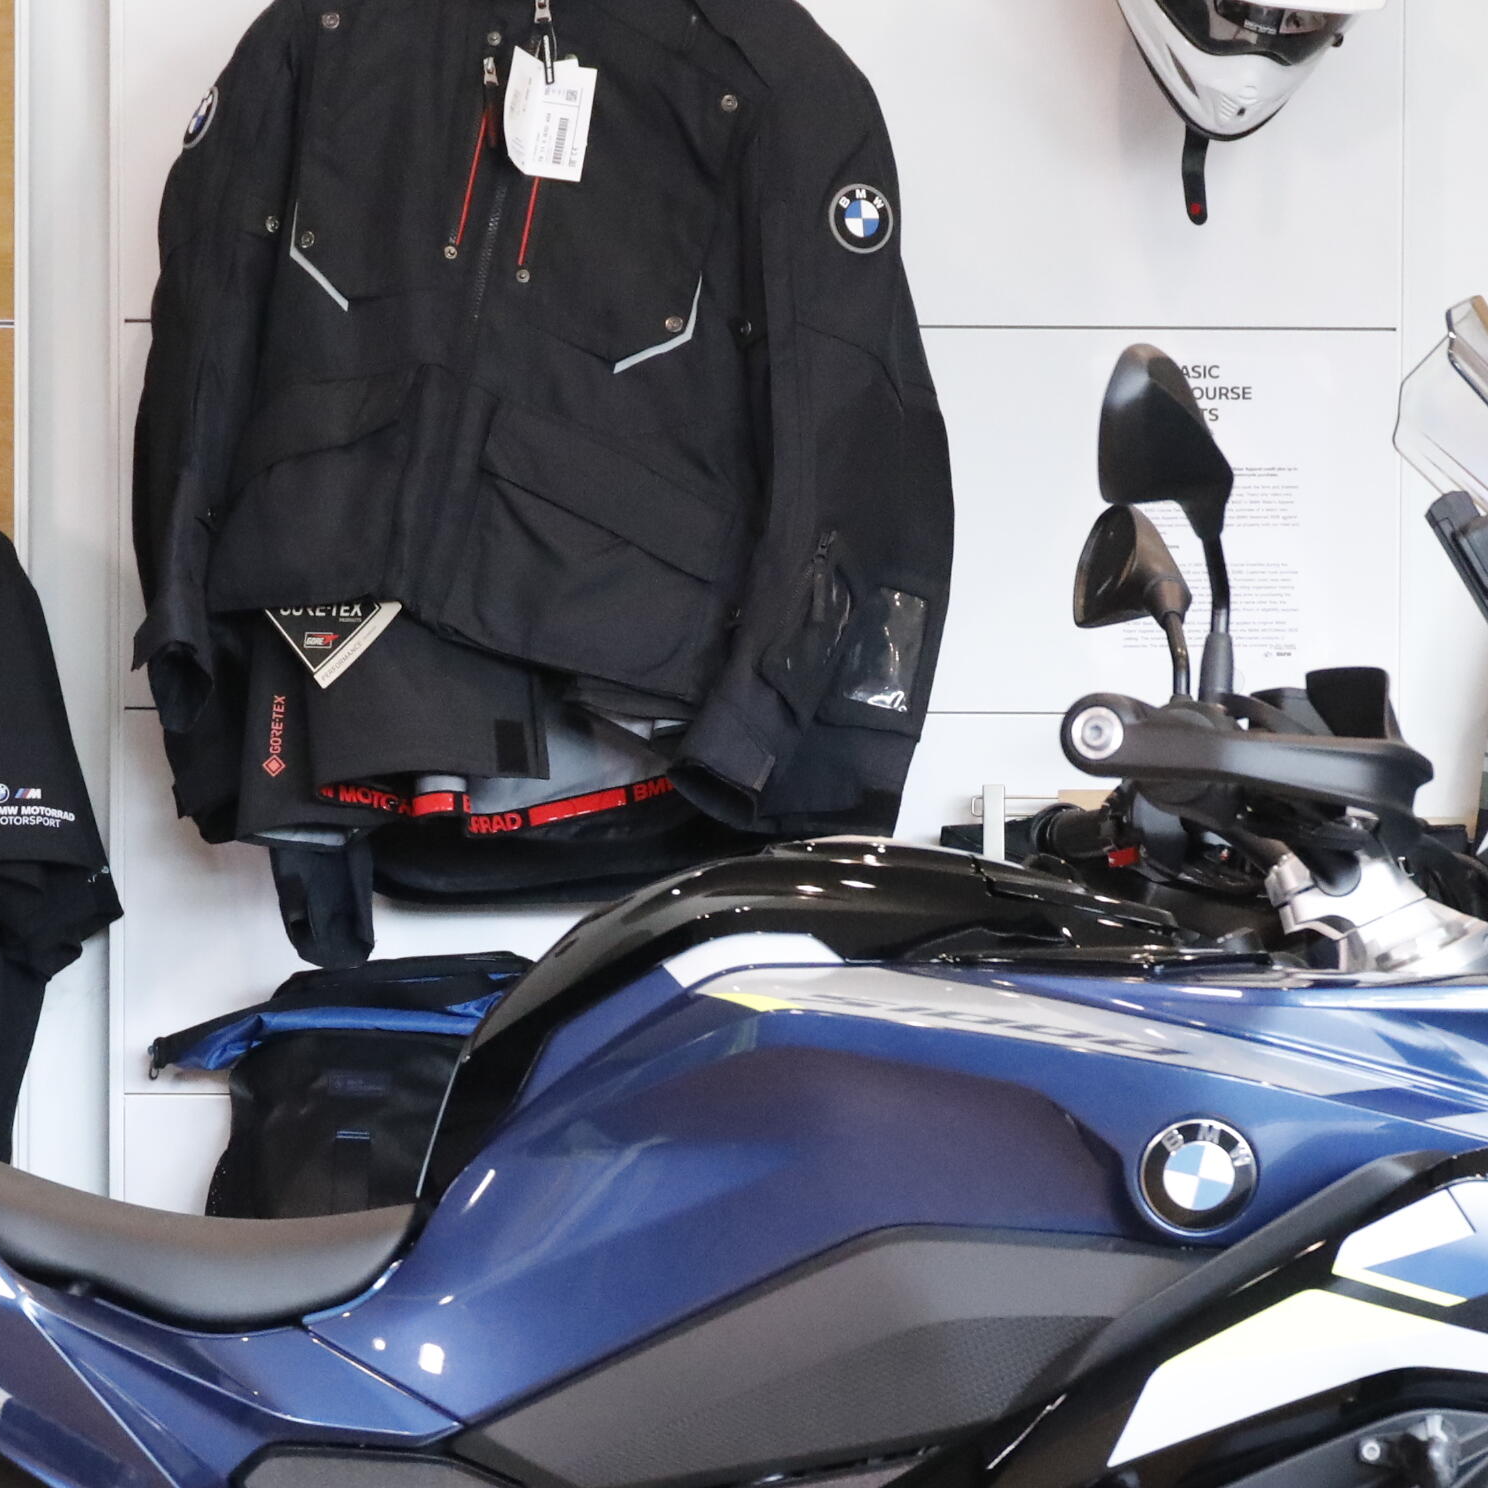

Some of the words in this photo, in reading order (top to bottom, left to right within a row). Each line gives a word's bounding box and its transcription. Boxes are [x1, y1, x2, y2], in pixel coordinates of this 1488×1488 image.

[838, 188, 884, 209] BMW
[1180, 365, 1221, 379] ASIC
[1192, 386, 1252, 400] OURSE
[321, 641, 363, 682] PERFORMANCE
[269, 694, 287, 754] GORE-TEX
[20, 805, 76, 822] MOTORRAD
[1160, 1122, 1252, 1168] BMW
